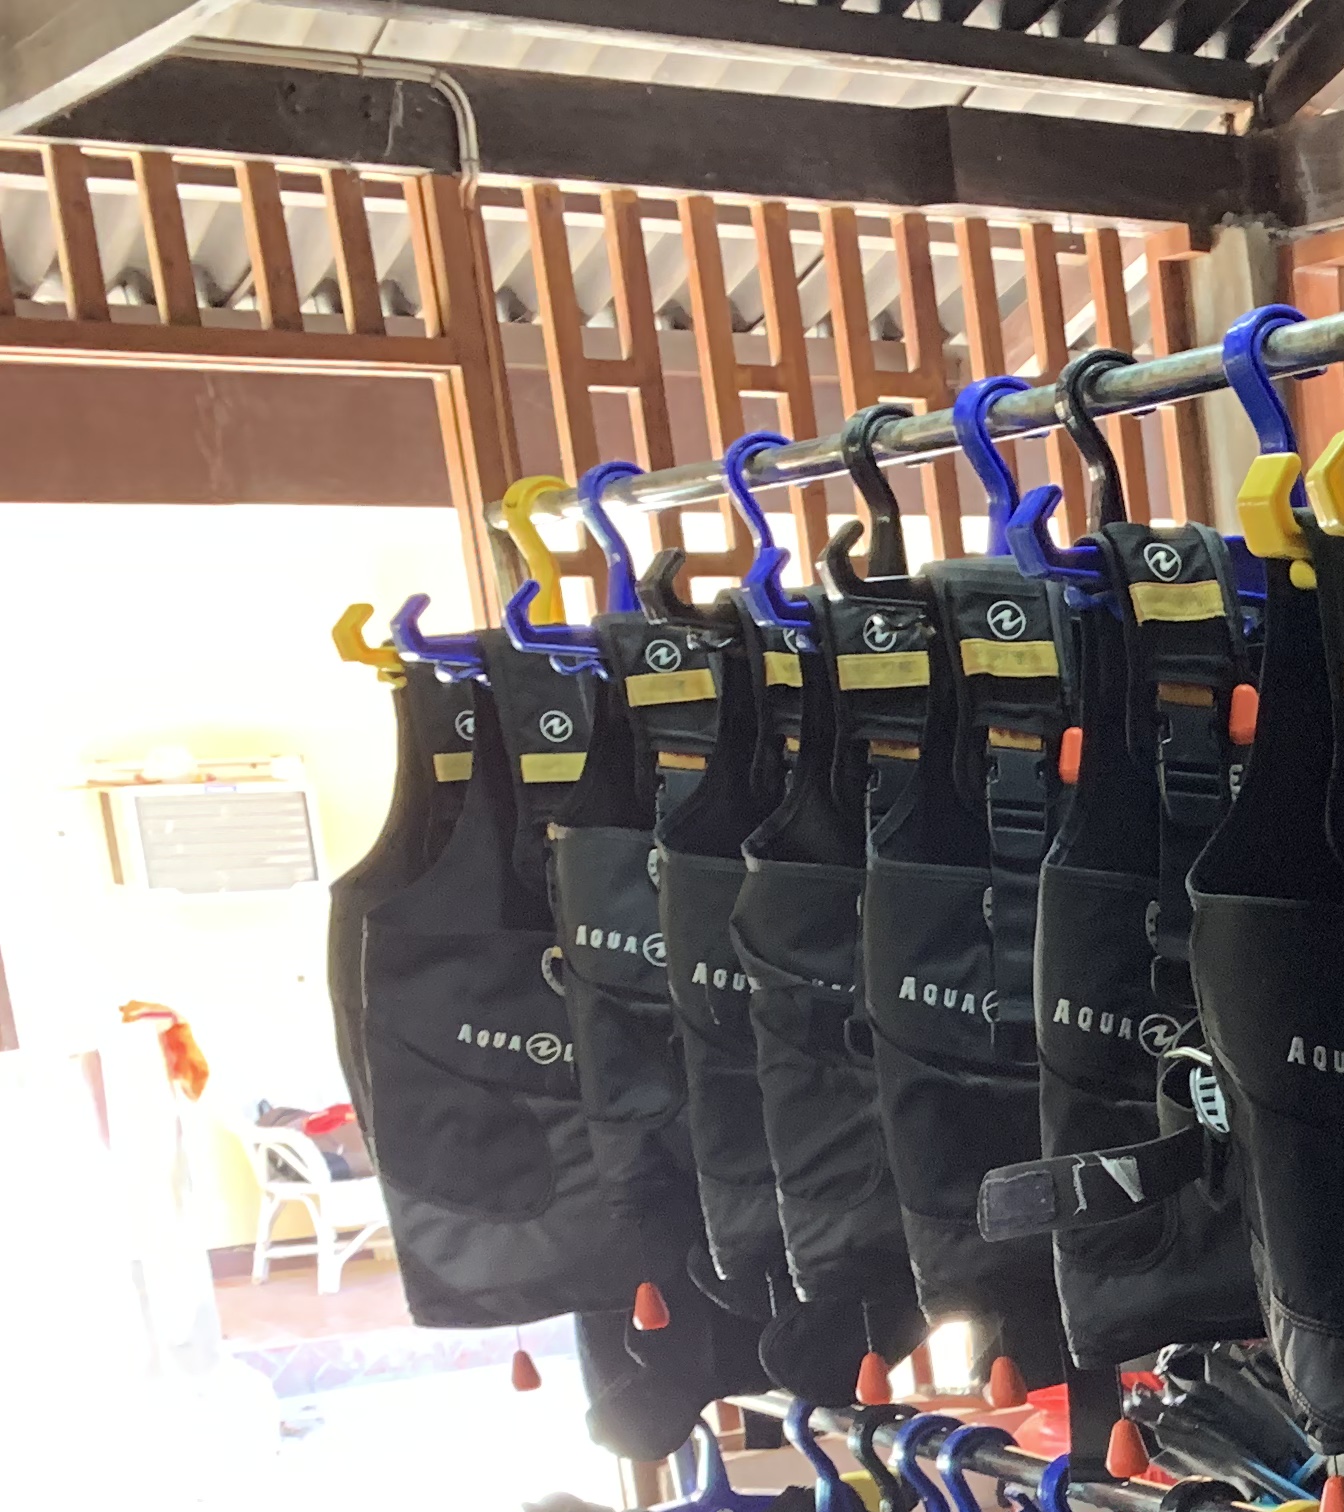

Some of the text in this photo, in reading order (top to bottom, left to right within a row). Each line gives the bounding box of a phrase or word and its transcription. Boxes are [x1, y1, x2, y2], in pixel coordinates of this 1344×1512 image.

[575, 925, 638, 955] AQUA
[691, 962, 757, 993] AQU
[899, 976, 975, 1015] AQUA
[1053, 998, 1133, 1040] AQUA
[457, 1024, 521, 1052] AQUA
